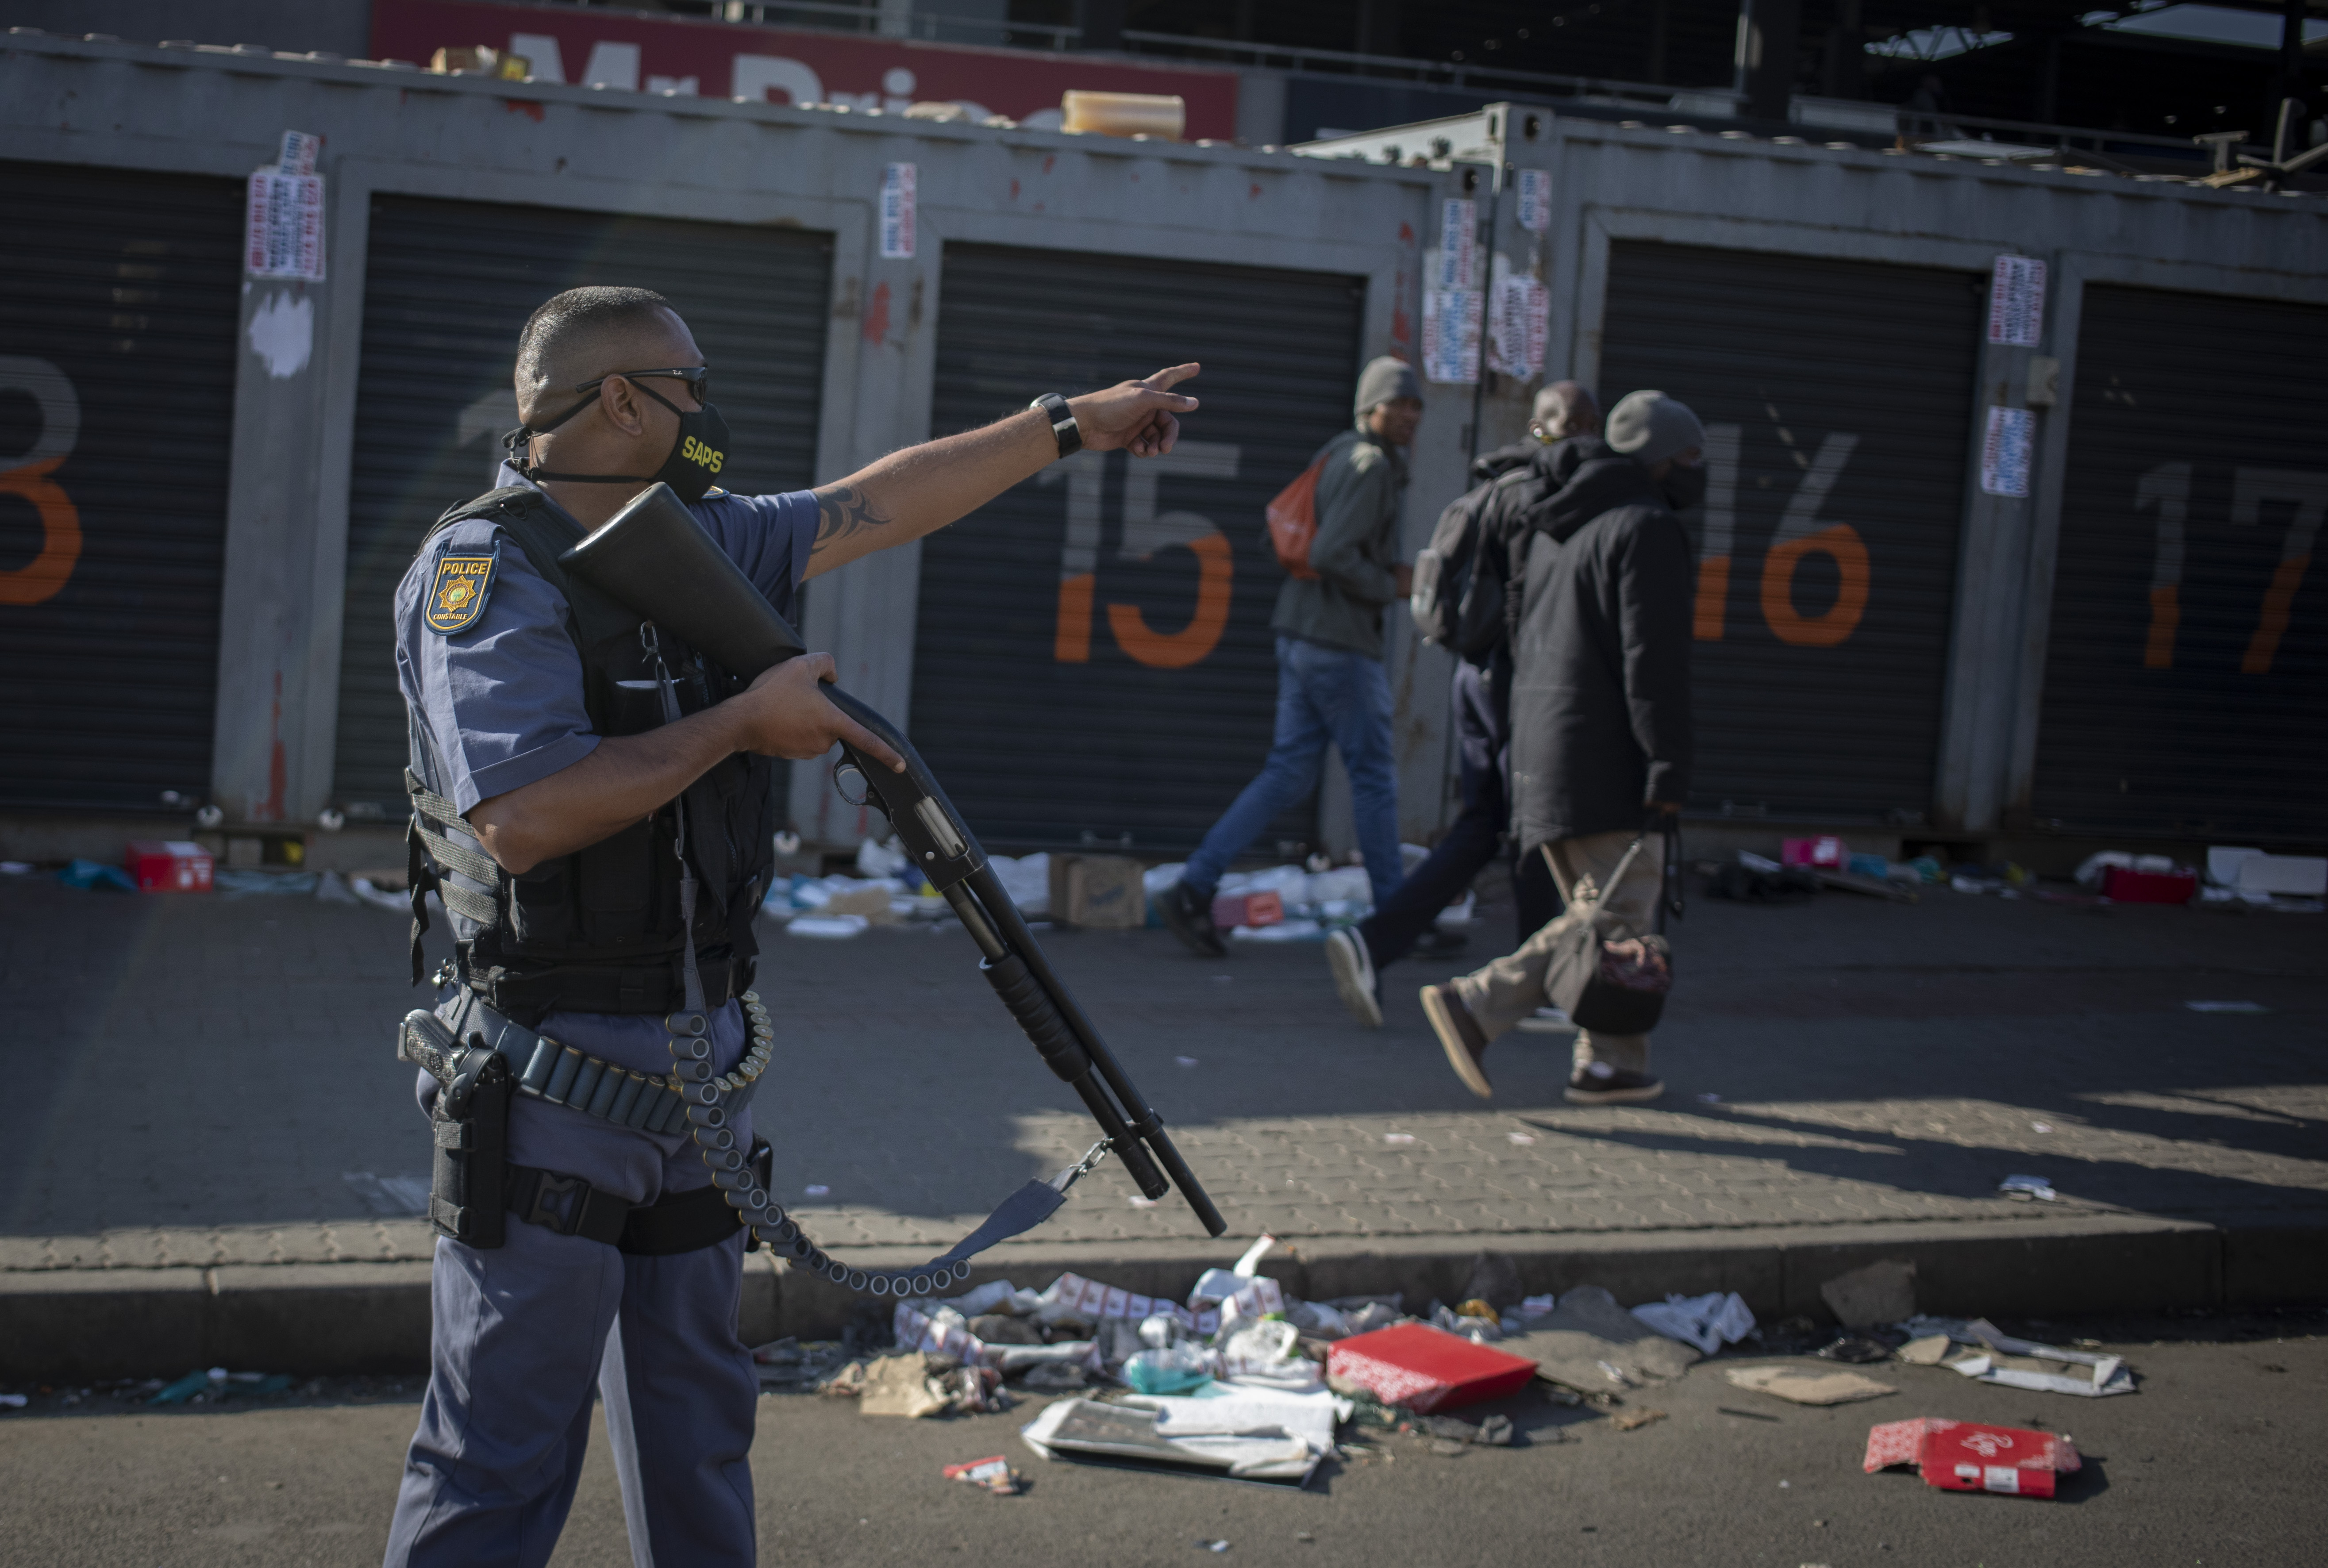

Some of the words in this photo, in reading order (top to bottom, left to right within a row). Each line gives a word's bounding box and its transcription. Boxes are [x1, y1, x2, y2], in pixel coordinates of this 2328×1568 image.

[682, 435, 723, 473] SAPS
[1035, 439, 1241, 669] 15
[1693, 423, 1871, 648] 16
[443, 563, 488, 575] POLICE
[2134, 460, 2328, 675] 17
